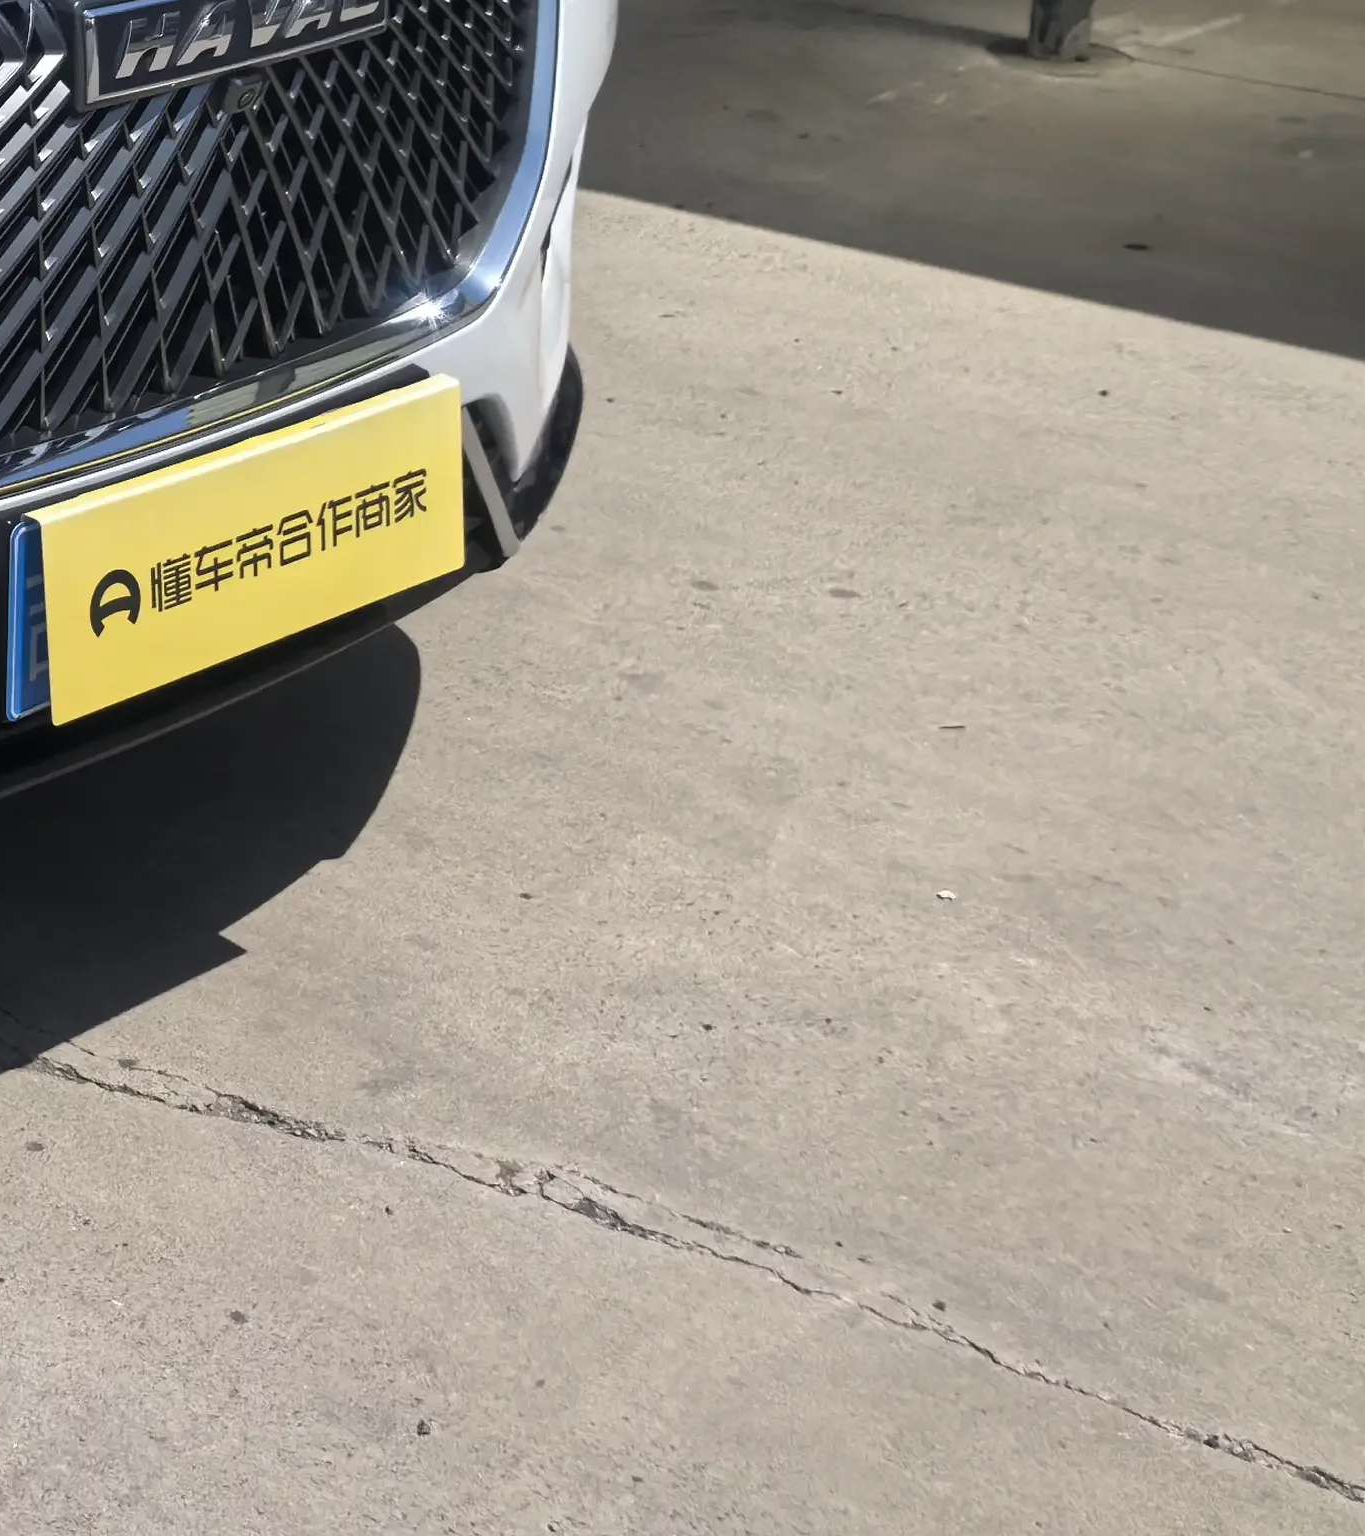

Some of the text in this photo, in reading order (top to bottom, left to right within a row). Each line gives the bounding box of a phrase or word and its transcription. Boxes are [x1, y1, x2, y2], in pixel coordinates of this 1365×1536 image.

[149, 467, 428, 612] 懂车帝合作商家
